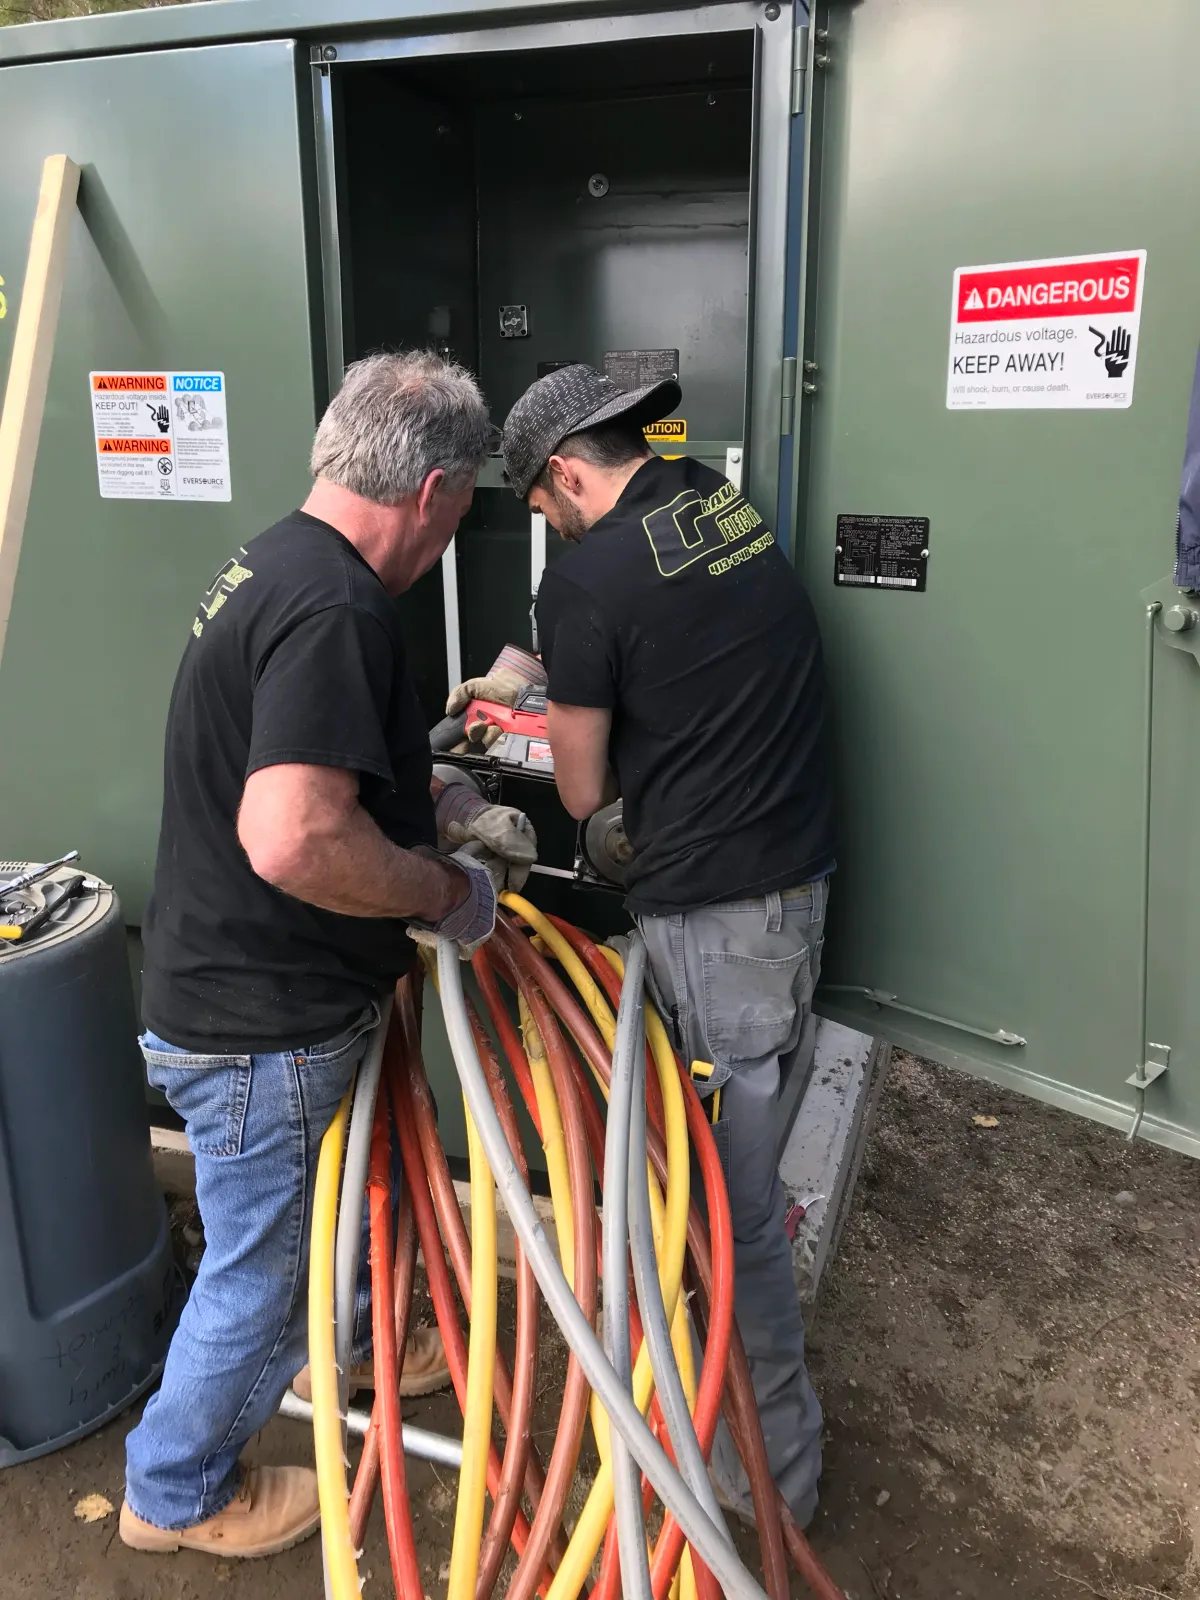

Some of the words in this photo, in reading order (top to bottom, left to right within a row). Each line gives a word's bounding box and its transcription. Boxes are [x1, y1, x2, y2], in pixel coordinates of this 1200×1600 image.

[987, 276, 1130, 308] DANGEROUS
[955, 331, 1021, 345] Hazardous
[1026, 327, 1078, 342] voltage.
[953, 355, 1000, 374] KEEP
[1005, 352, 1065, 373] AWAY!
[108, 377, 165, 390] WARNING
[175, 377, 219, 390] NOTICE
[953, 386, 965, 394] Will
[992, 385, 1011, 395] burn,
[1022, 385, 1045, 393] cause
[1047, 384, 1071, 392] death.
[94, 393, 125, 401] Hazardous
[127, 394, 147, 402] voltage
[95, 402, 116, 410] KEEP
[118, 402, 138, 410] OUT!
[643, 423, 681, 434] UTION
[113, 440, 169, 452] WARNING
